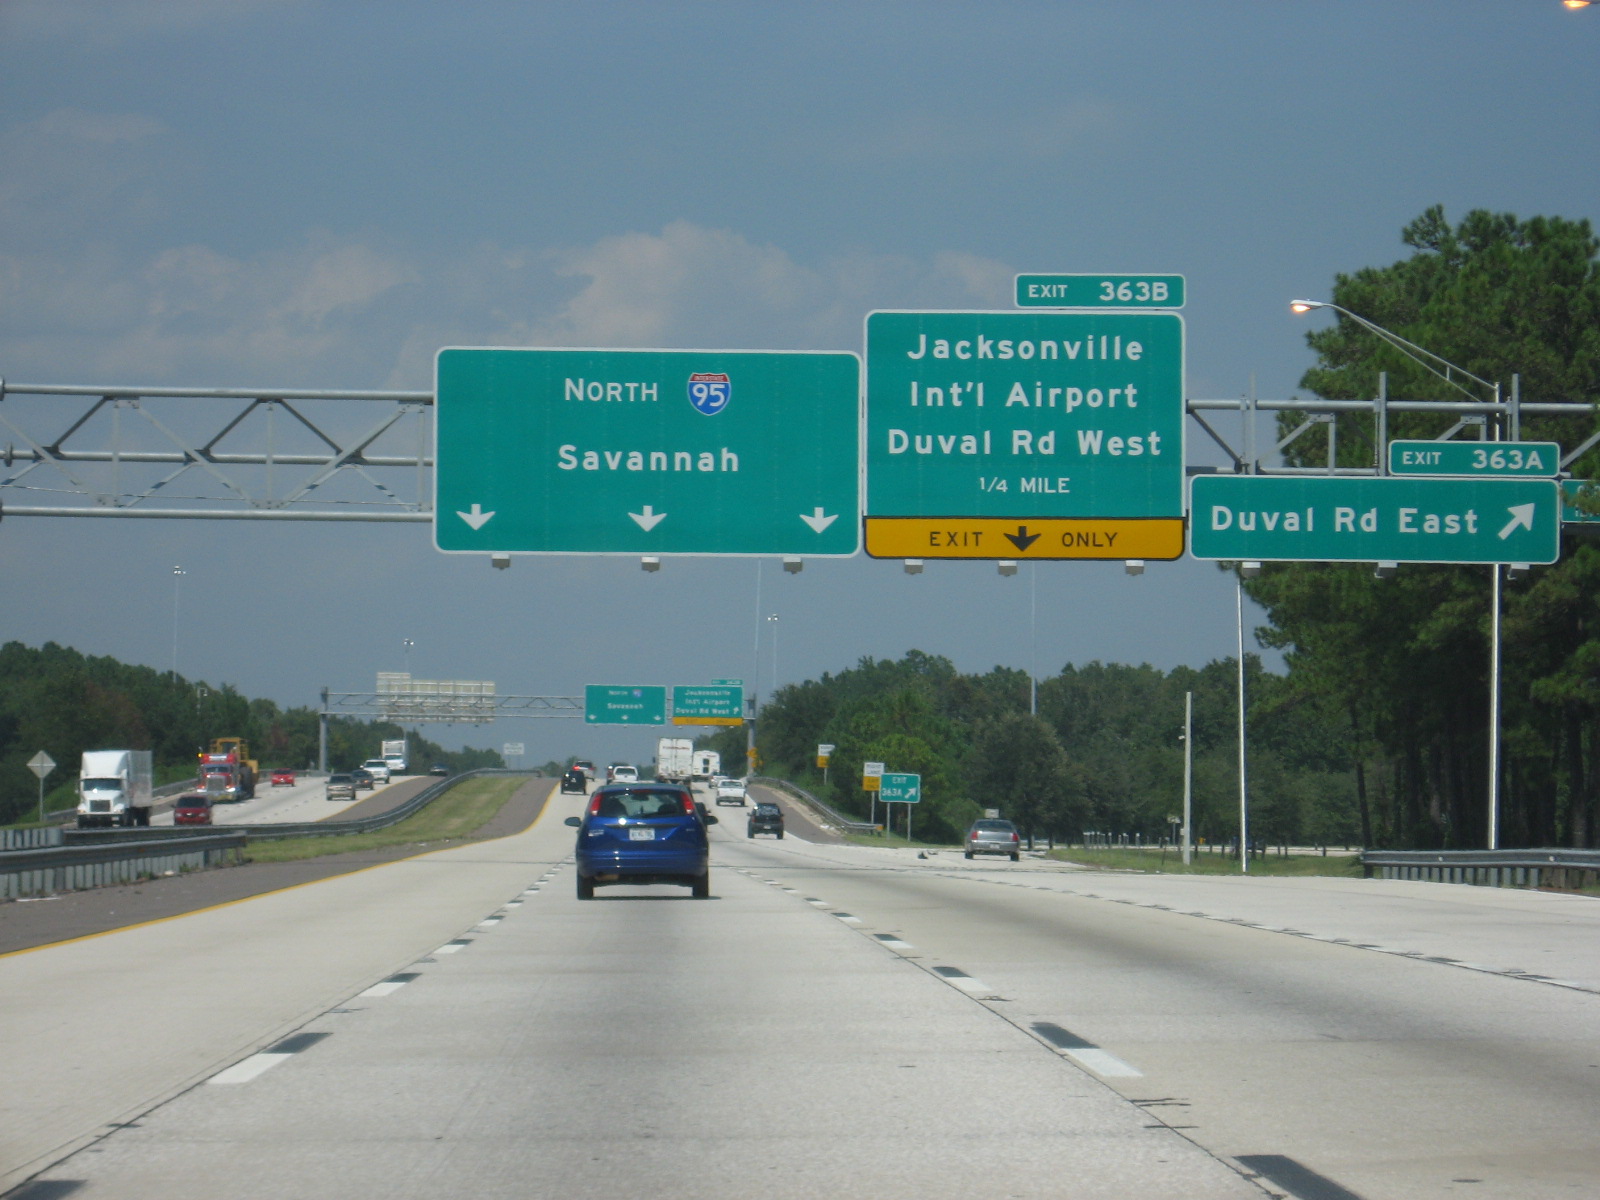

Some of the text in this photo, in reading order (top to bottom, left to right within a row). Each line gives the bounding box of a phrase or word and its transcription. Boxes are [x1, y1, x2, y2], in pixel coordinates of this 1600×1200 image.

[1028, 281, 1169, 302] EXIT 363B
[907, 334, 1143, 361] Jacksonville
[692, 383, 725, 407] 95
[911, 381, 1137, 413] Int'l Airport
[888, 428, 1161, 456] Duval Rd West
[557, 444, 739, 472] Savannah
[1402, 449, 1543, 470] EXIT 363A
[979, 477, 1070, 494] 1/4 MILE
[1211, 505, 1478, 534] Duval Rd East
[930, 531, 1118, 548] EXIT ONLY
